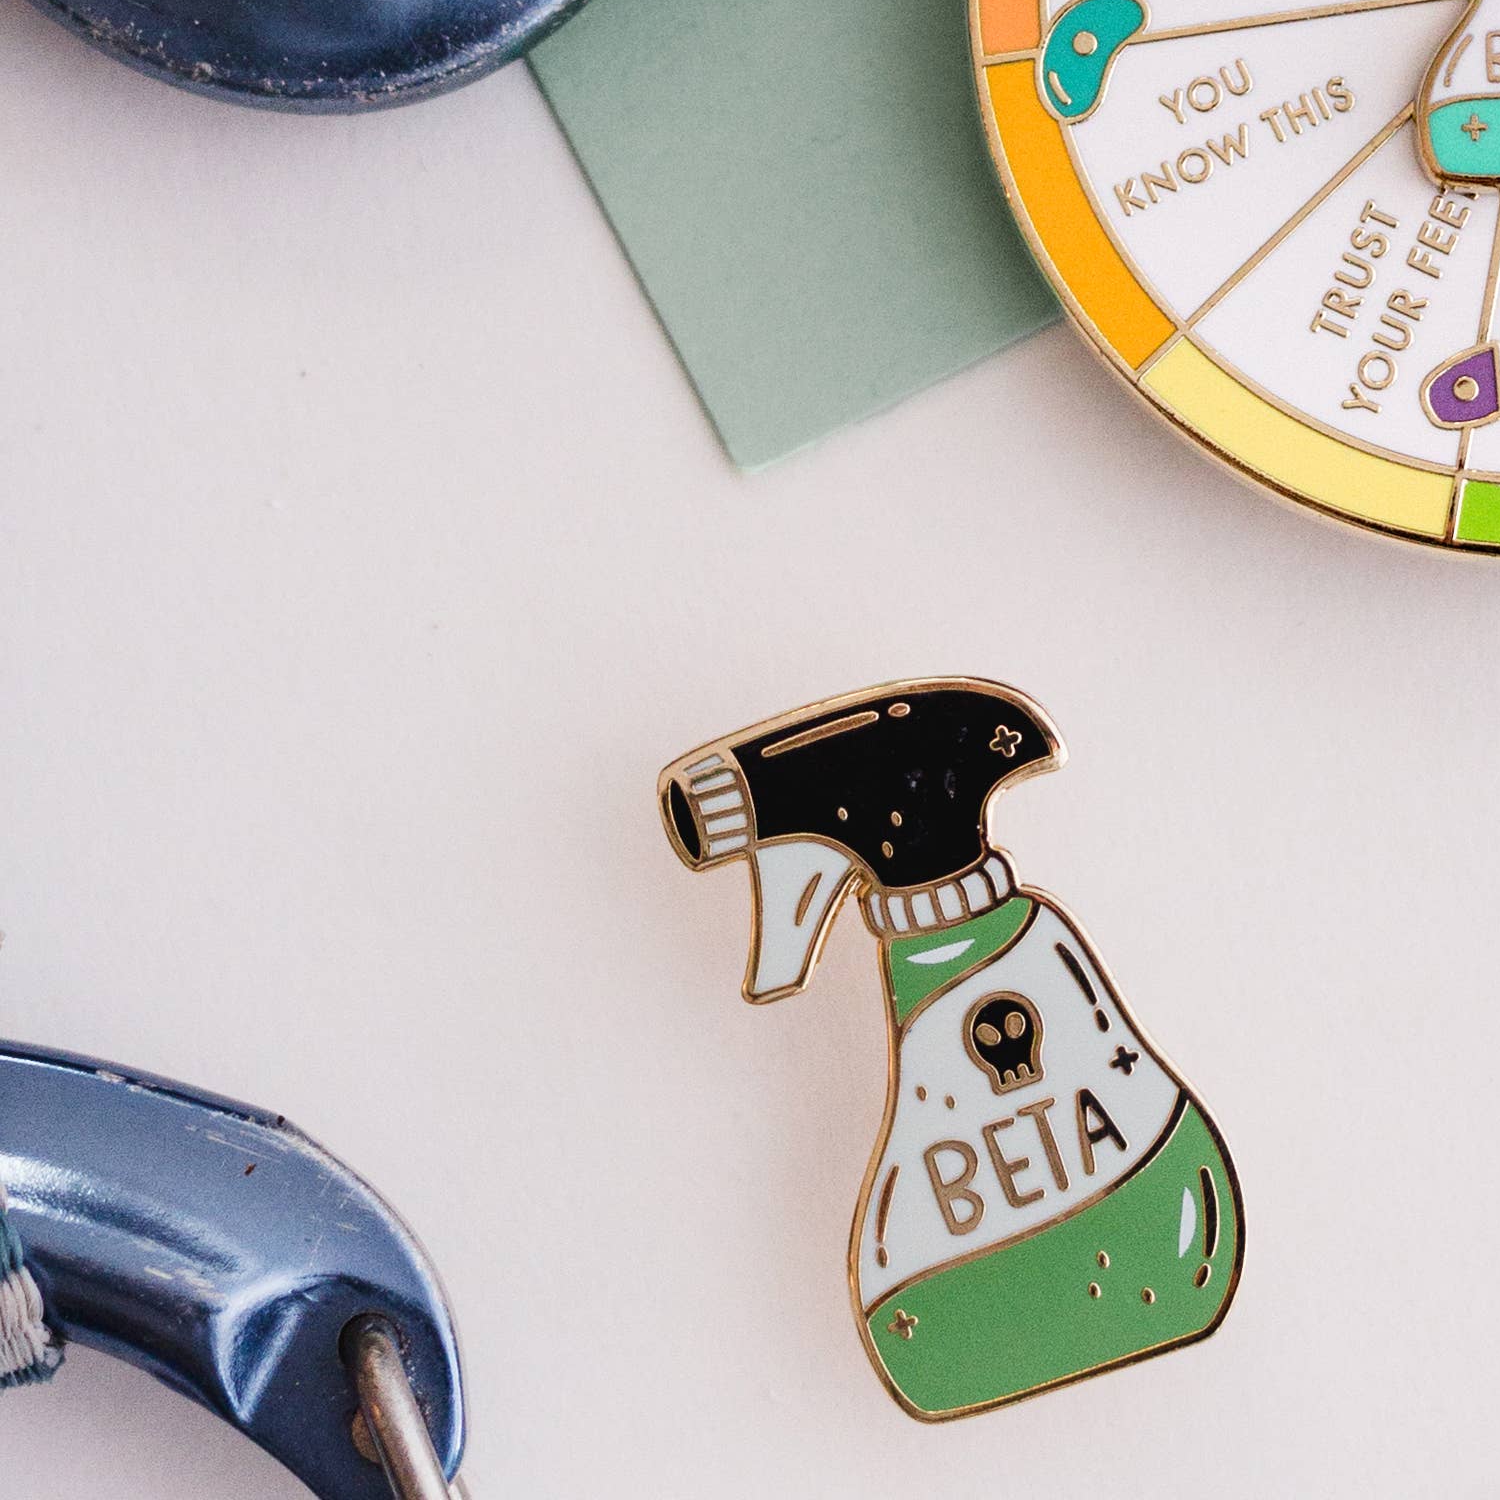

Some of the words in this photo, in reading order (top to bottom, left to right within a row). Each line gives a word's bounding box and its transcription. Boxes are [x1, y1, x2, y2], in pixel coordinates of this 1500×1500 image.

[1113, 123, 1251, 216] KNOW
[1259, 75, 1356, 143] THIS
[1159, 59, 1254, 124] YOU
[1310, 200, 1400, 338] TRUST
[1342, 287, 1429, 414] YOUR
[924, 1087, 1128, 1236] BETA
